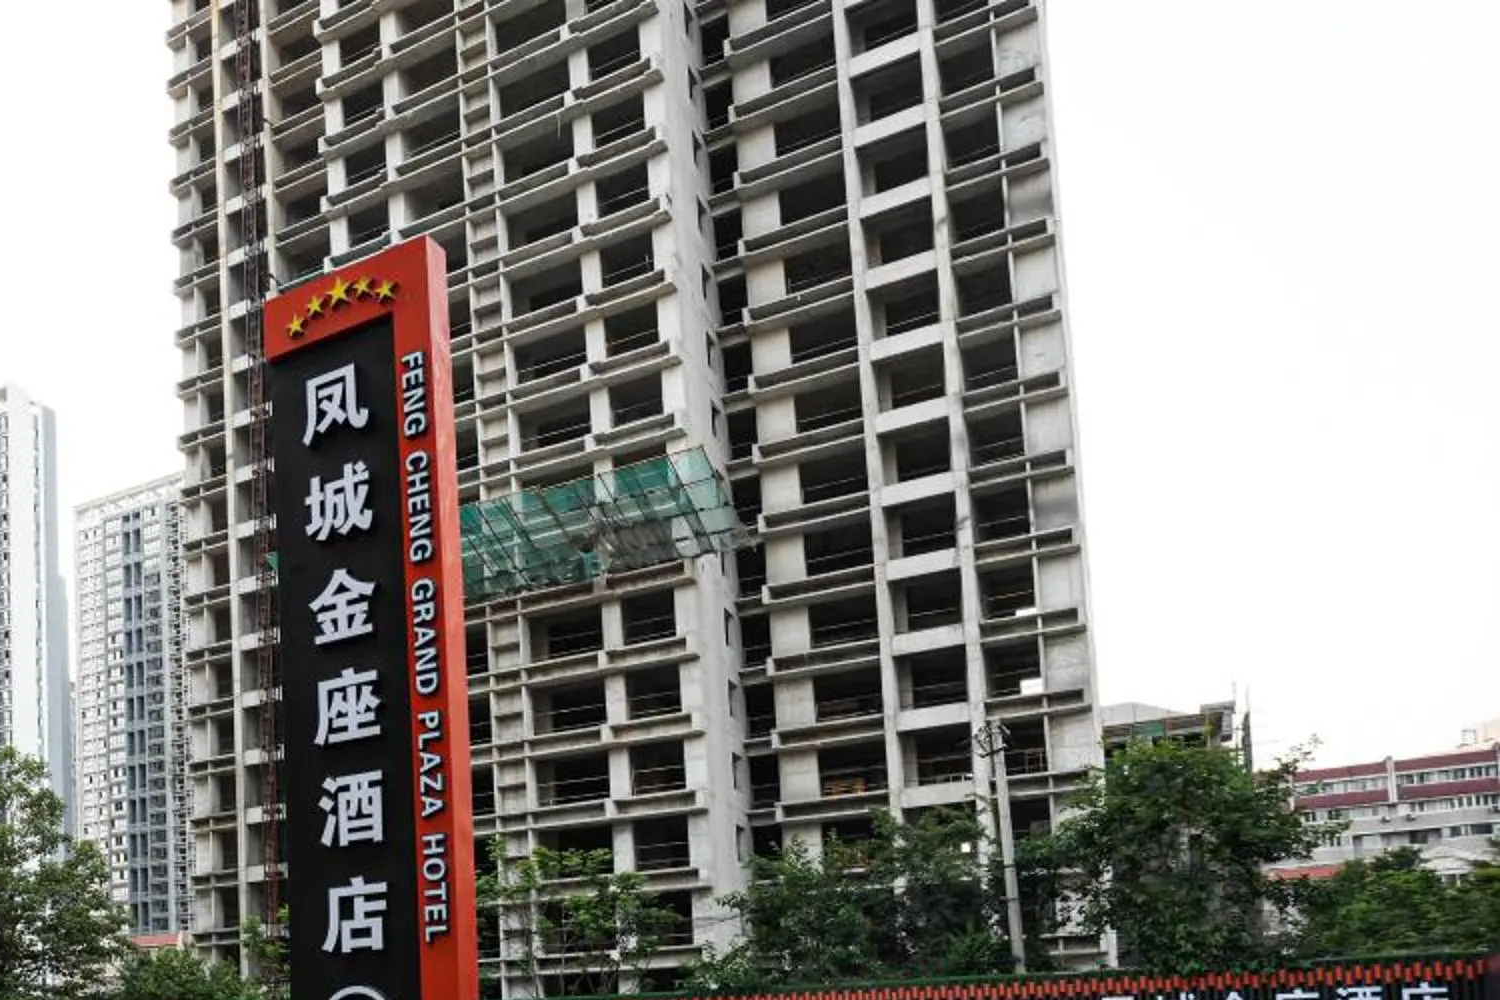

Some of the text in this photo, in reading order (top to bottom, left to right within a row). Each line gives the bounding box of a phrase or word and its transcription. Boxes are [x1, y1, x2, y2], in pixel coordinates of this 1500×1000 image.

[303, 362, 388, 954] 凤城金座酒店
[401, 350, 448, 944] FENG CHENG GRAND PLAZA HOTEL
